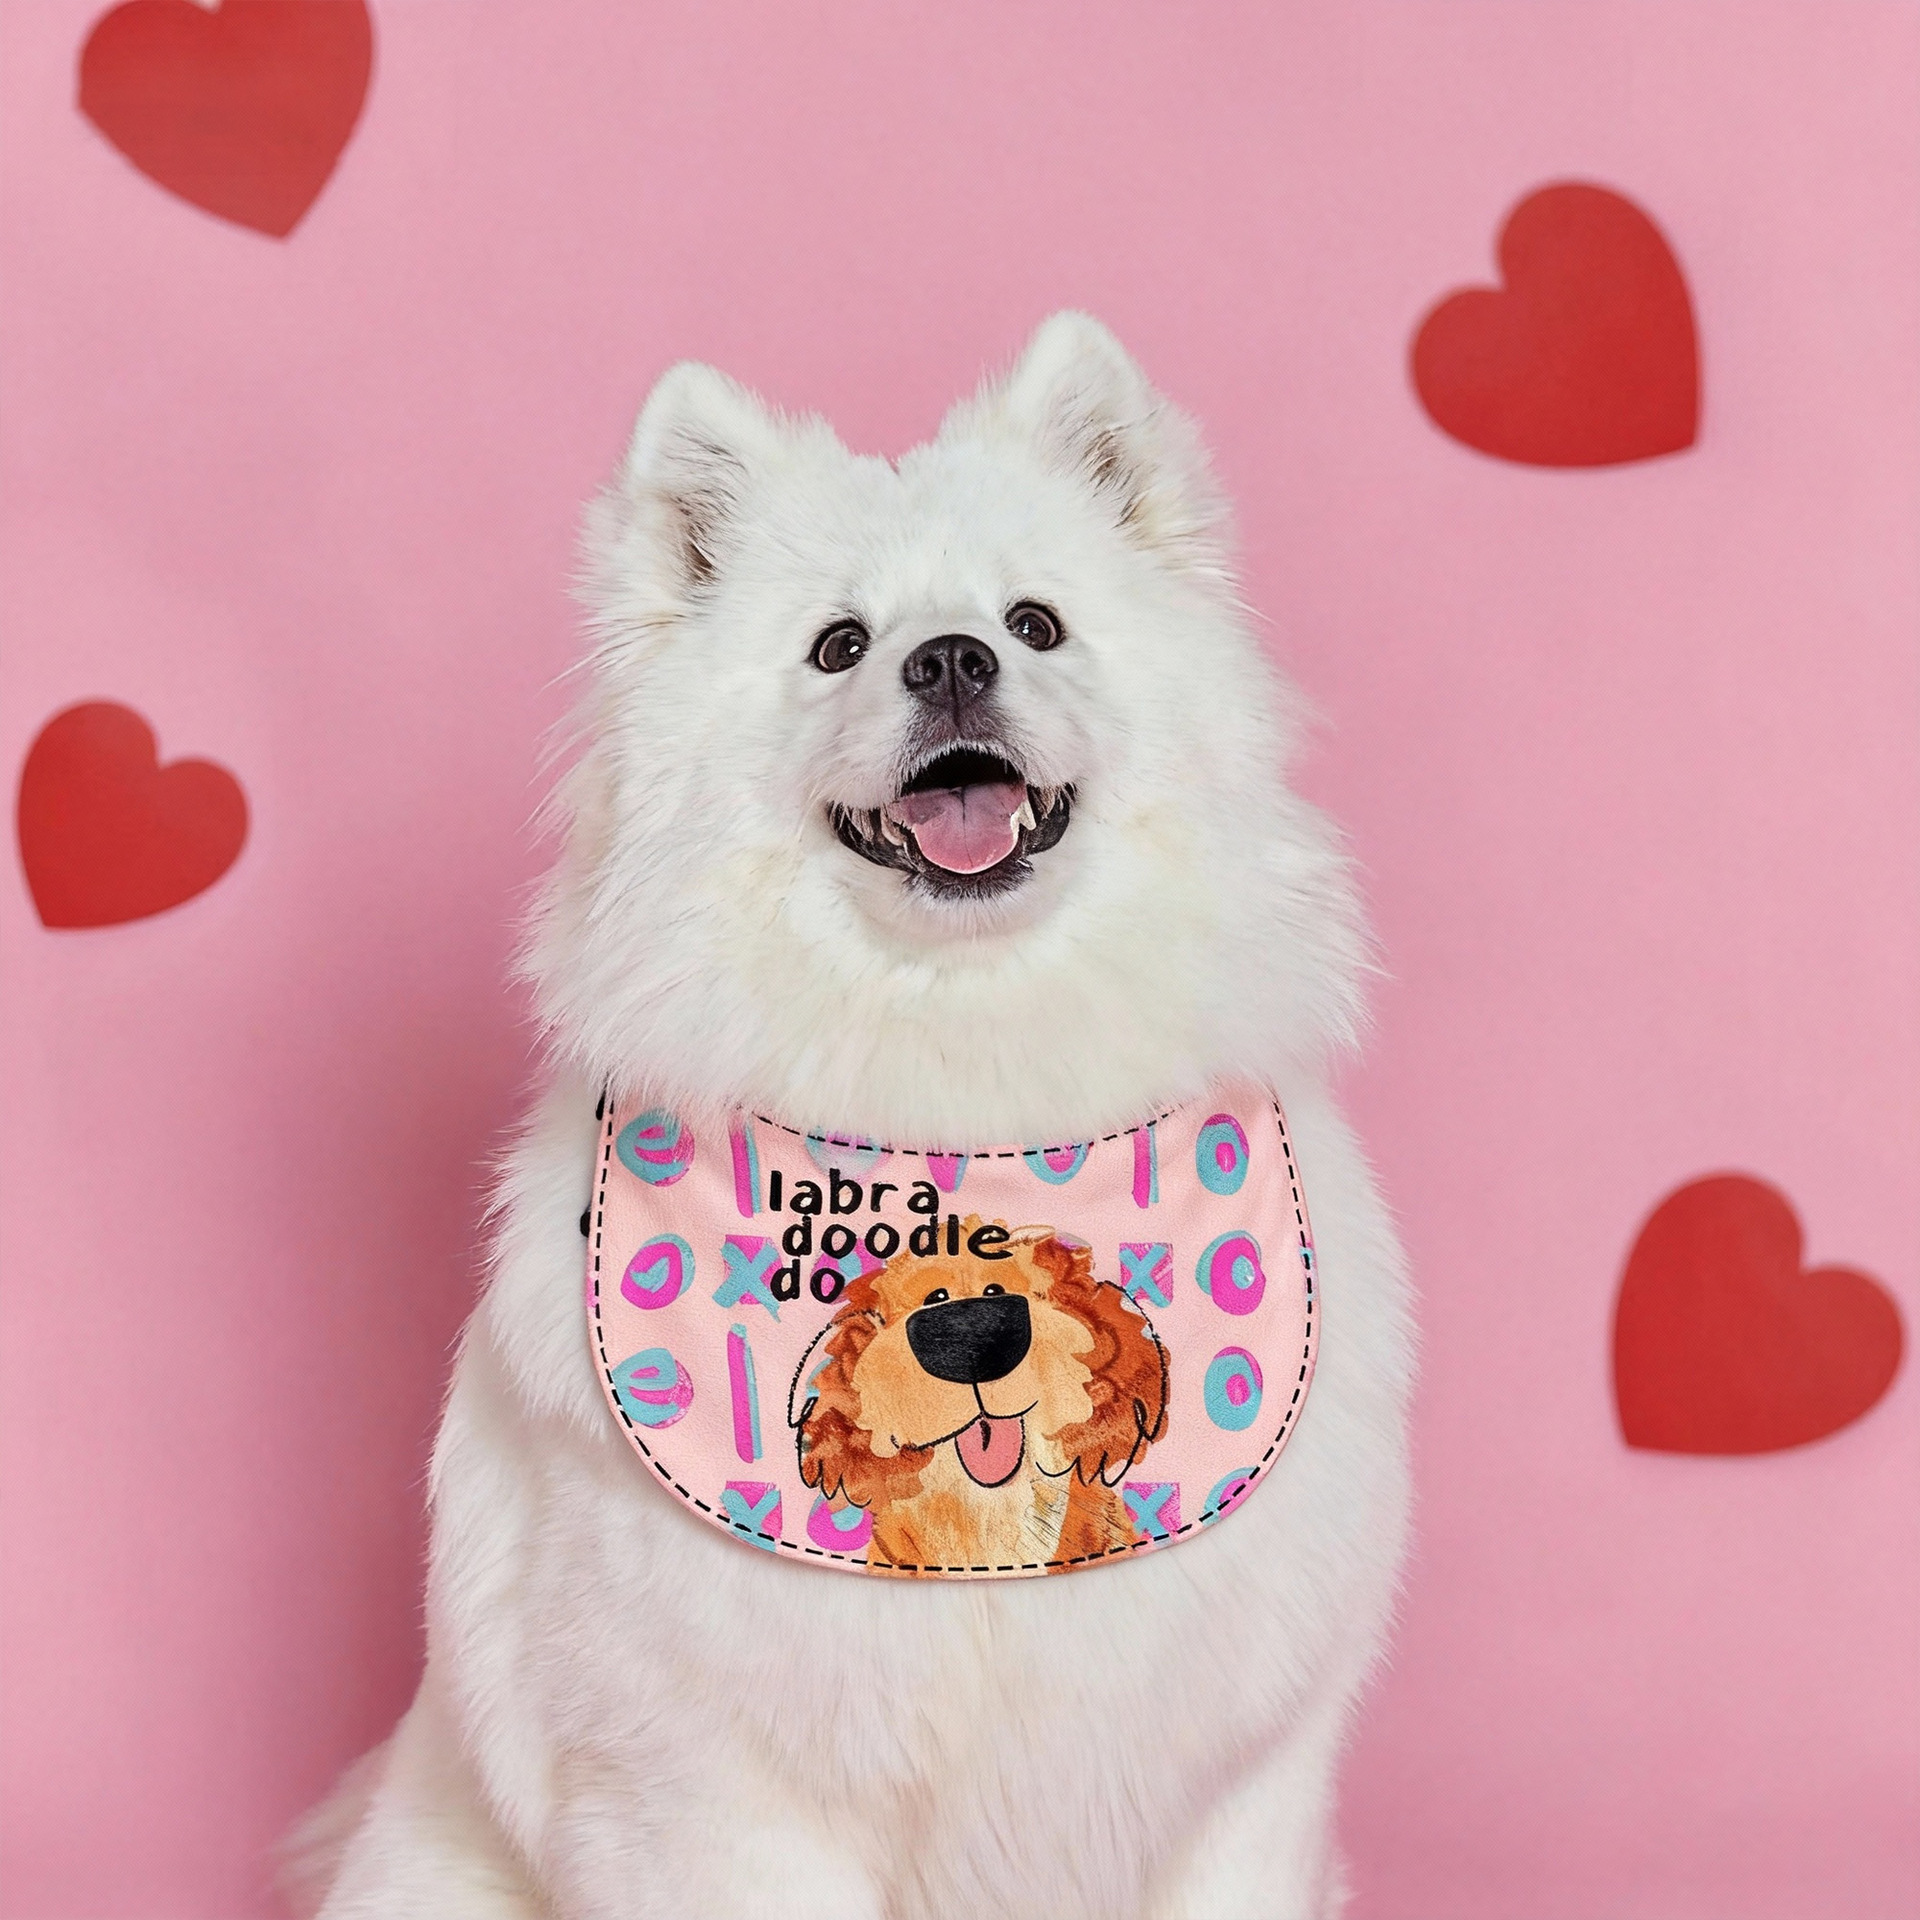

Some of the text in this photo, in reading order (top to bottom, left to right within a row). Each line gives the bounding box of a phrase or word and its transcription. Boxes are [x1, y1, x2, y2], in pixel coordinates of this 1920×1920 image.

[768, 1167, 940, 1216] labra
[781, 1213, 1014, 1261] doodle
[769, 1258, 846, 1305] do
